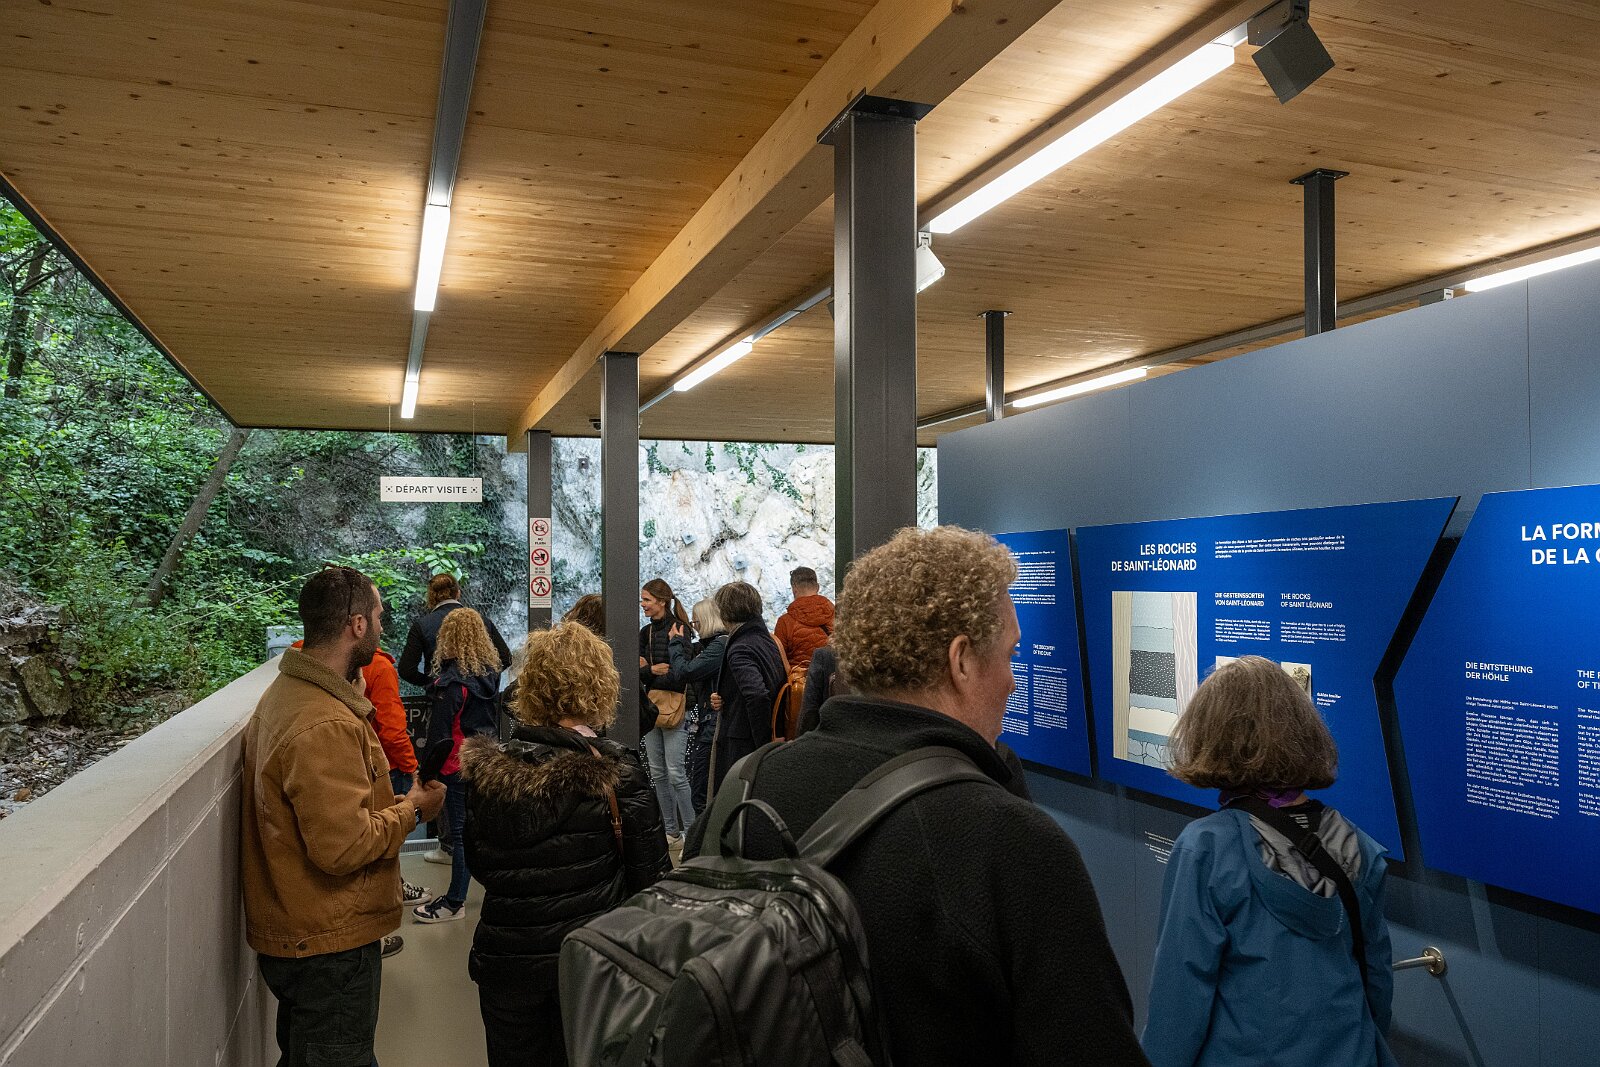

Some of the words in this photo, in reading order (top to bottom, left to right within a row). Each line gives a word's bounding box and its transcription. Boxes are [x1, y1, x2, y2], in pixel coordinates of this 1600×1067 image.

[396, 484, 434, 494] DÉPART
[436, 486, 468, 494] VISITE
[1522, 525, 1546, 541] LA
[1140, 544, 1156, 556] LES
[1158, 542, 1196, 554] ROCHES
[1532, 549, 1556, 564] DE
[1563, 548, 1590, 564] LA
[1112, 561, 1122, 571] DE
[1124, 558, 1196, 571] SAINT-LÉONARD
[1306, 600, 1332, 608] LÉONARD
[1466, 661, 1478, 670] DIE
[1480, 663, 1533, 674] ENTSTEHUNG
[1466, 672, 1480, 680] DER
[1482, 671, 1509, 682] HÖHLE
[1577, 670, 1595, 679] THE
[1578, 681, 1590, 689] OF
